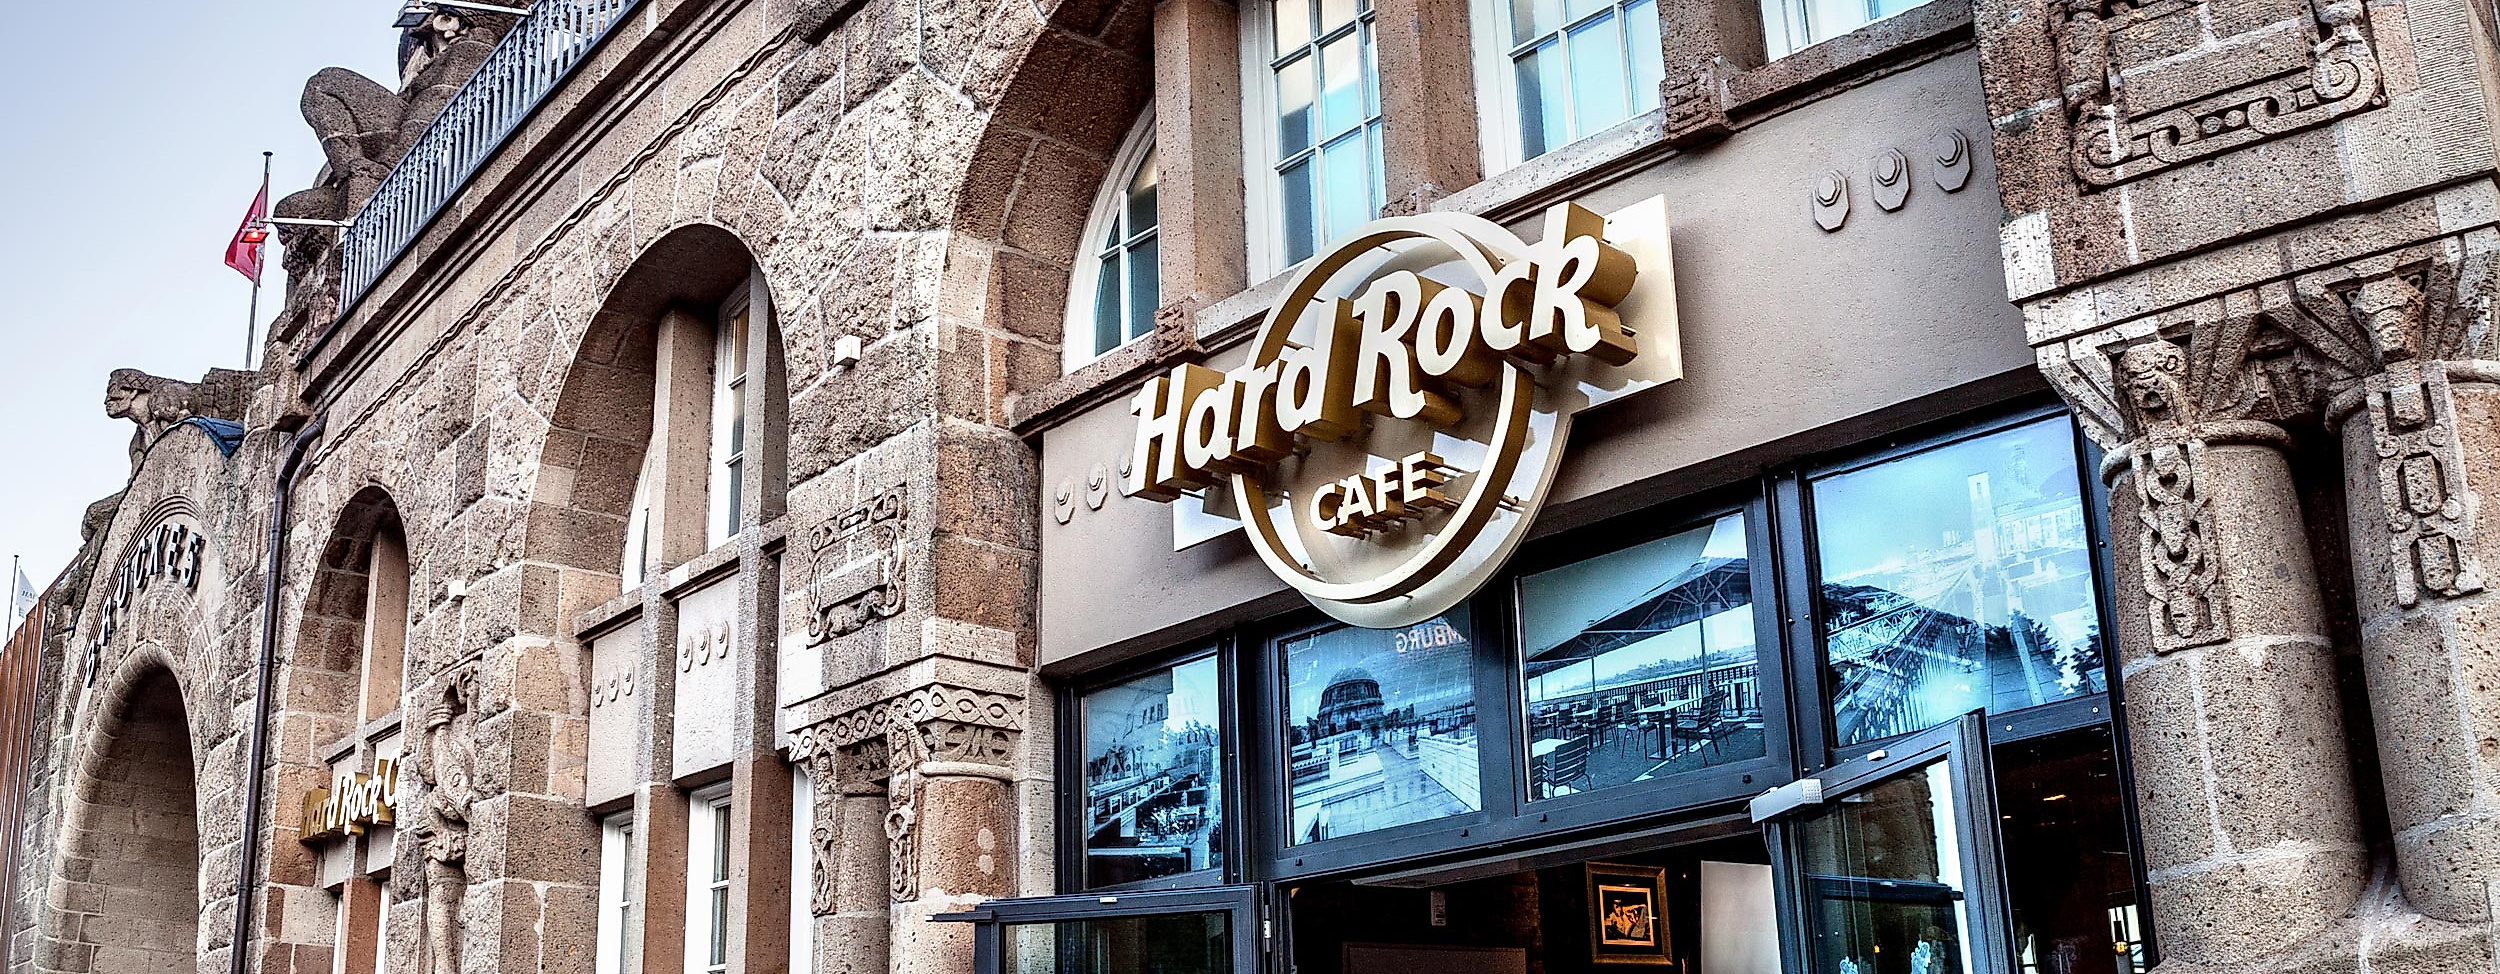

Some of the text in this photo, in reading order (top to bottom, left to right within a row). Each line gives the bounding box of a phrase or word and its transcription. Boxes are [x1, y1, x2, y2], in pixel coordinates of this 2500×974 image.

[1129, 201, 1602, 497] Hard Rock
[1309, 453, 1429, 532] CAFE
[338, 757, 382, 836] Rock
